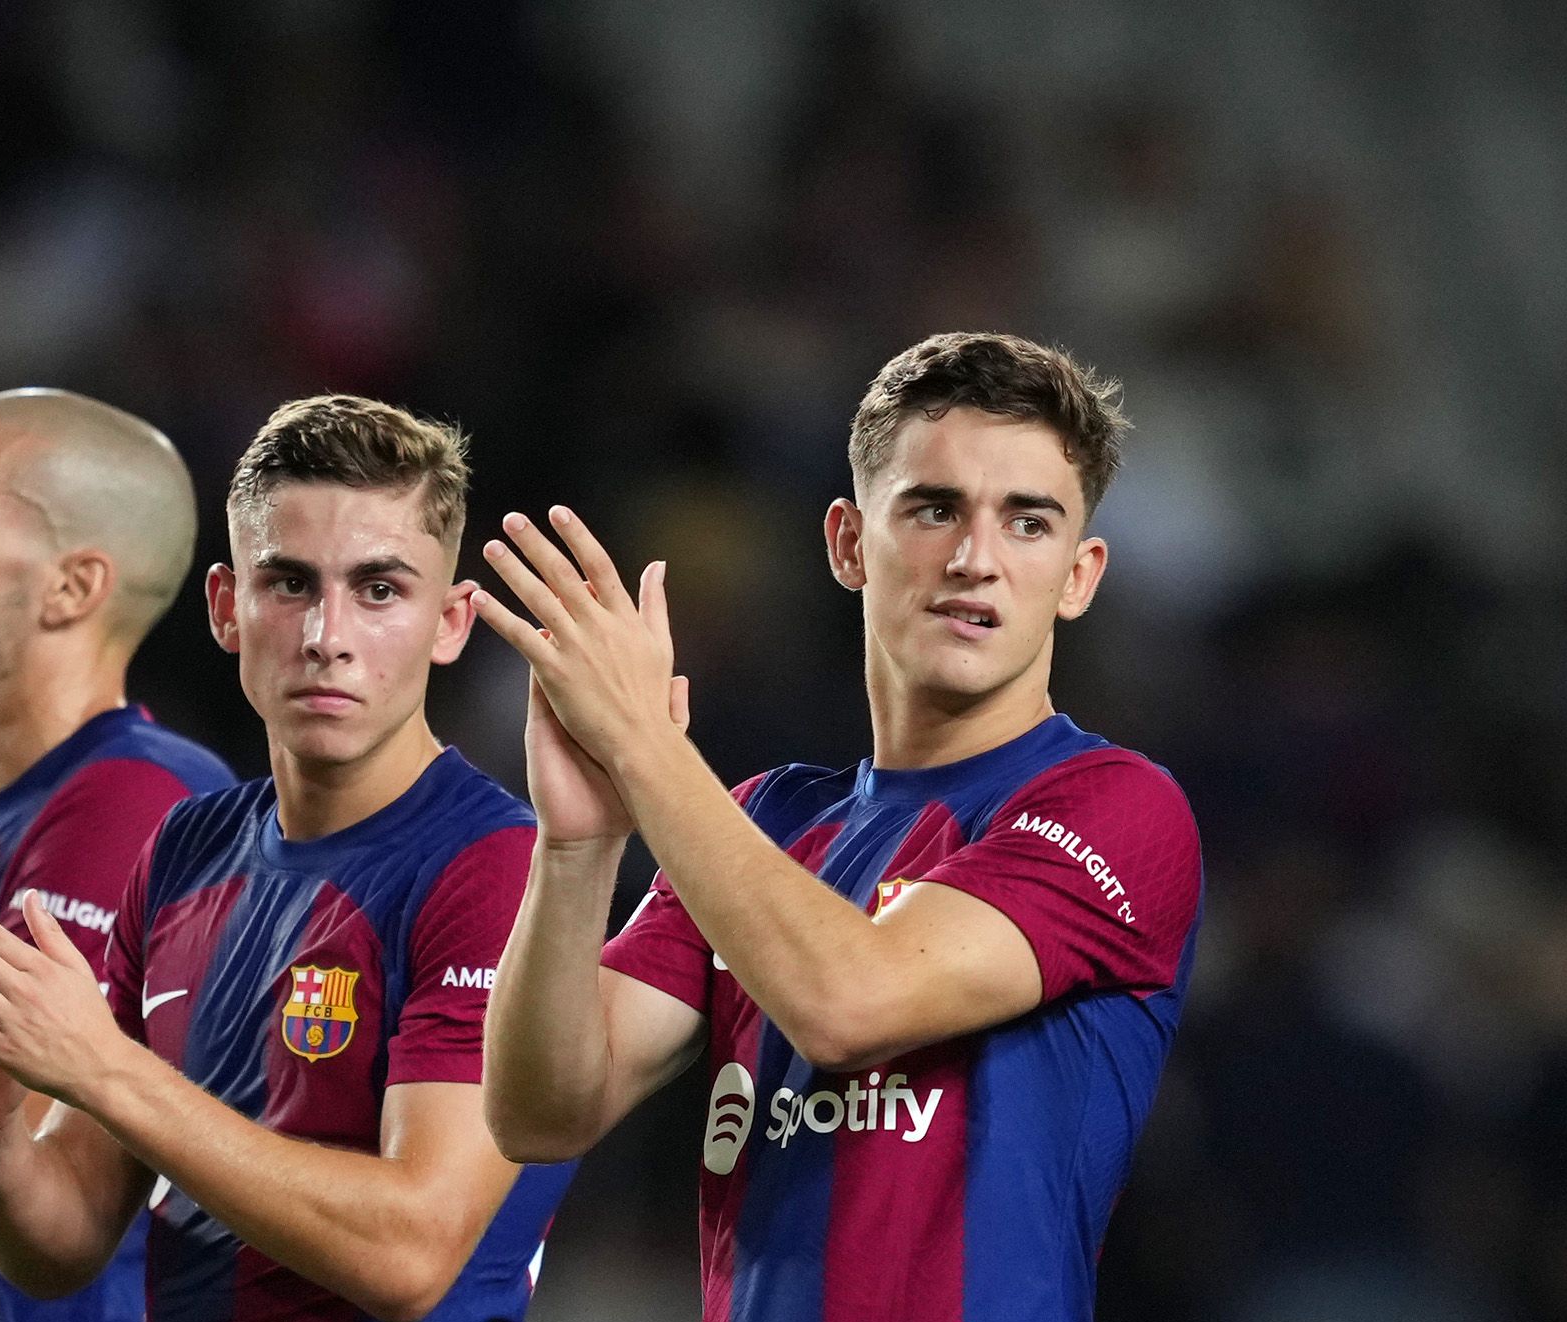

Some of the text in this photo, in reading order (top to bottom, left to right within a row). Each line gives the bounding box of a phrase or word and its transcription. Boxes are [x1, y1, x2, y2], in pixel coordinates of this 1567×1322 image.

[1011, 812, 1136, 924] AMBILIGHT tv
[304, 1005, 332, 1018] FCB
[765, 1071, 944, 1149] Spotify
